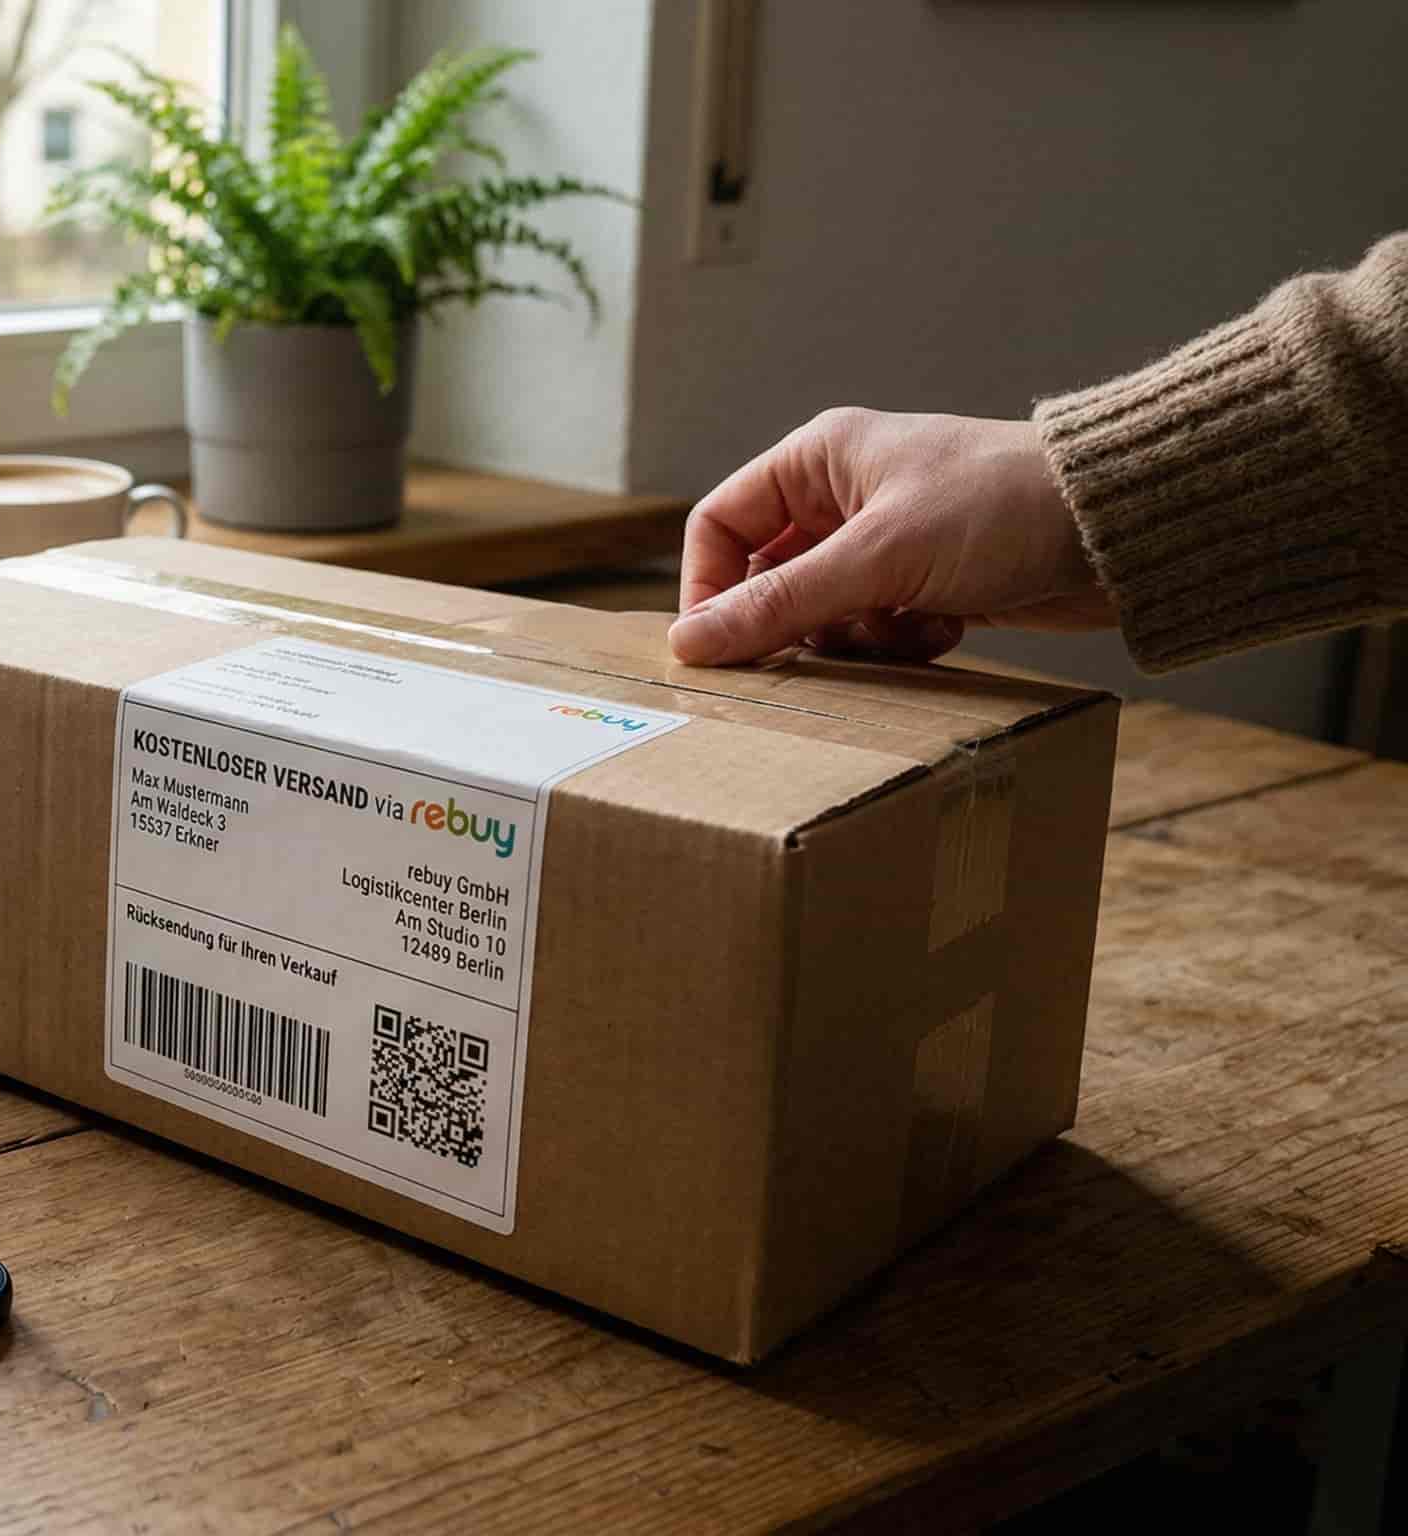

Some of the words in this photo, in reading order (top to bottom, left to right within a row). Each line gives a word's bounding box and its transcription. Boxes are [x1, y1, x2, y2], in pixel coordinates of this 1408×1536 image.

[548, 702, 647, 731] rebuy
[131, 790, 154, 810] Am
[156, 798, 213, 827] Waldeck
[218, 815, 226, 831] 3
[132, 767, 160, 791] Max
[163, 777, 249, 814] Mustermann
[133, 729, 266, 784] KOSTENLOSER
[273, 766, 368, 810] VERSAND
[374, 792, 403, 821] via
[410, 798, 516, 857] rebuy
[175, 826, 219, 853] Erkner
[342, 867, 455, 916] Logistikcenter
[459, 901, 507, 931] Berlin
[407, 864, 452, 893] rebuy
[457, 876, 509, 906] GmbH
[127, 904, 214, 951] Rücksendung
[218, 933, 237, 955] für
[241, 940, 276, 967] Ihren
[280, 954, 337, 987] Verkauf
[396, 909, 422, 933] Am
[427, 918, 479, 947] Studio
[485, 936, 505, 956] 10
[401, 935, 451, 965] 12489
[457, 948, 503, 981] Berlin
